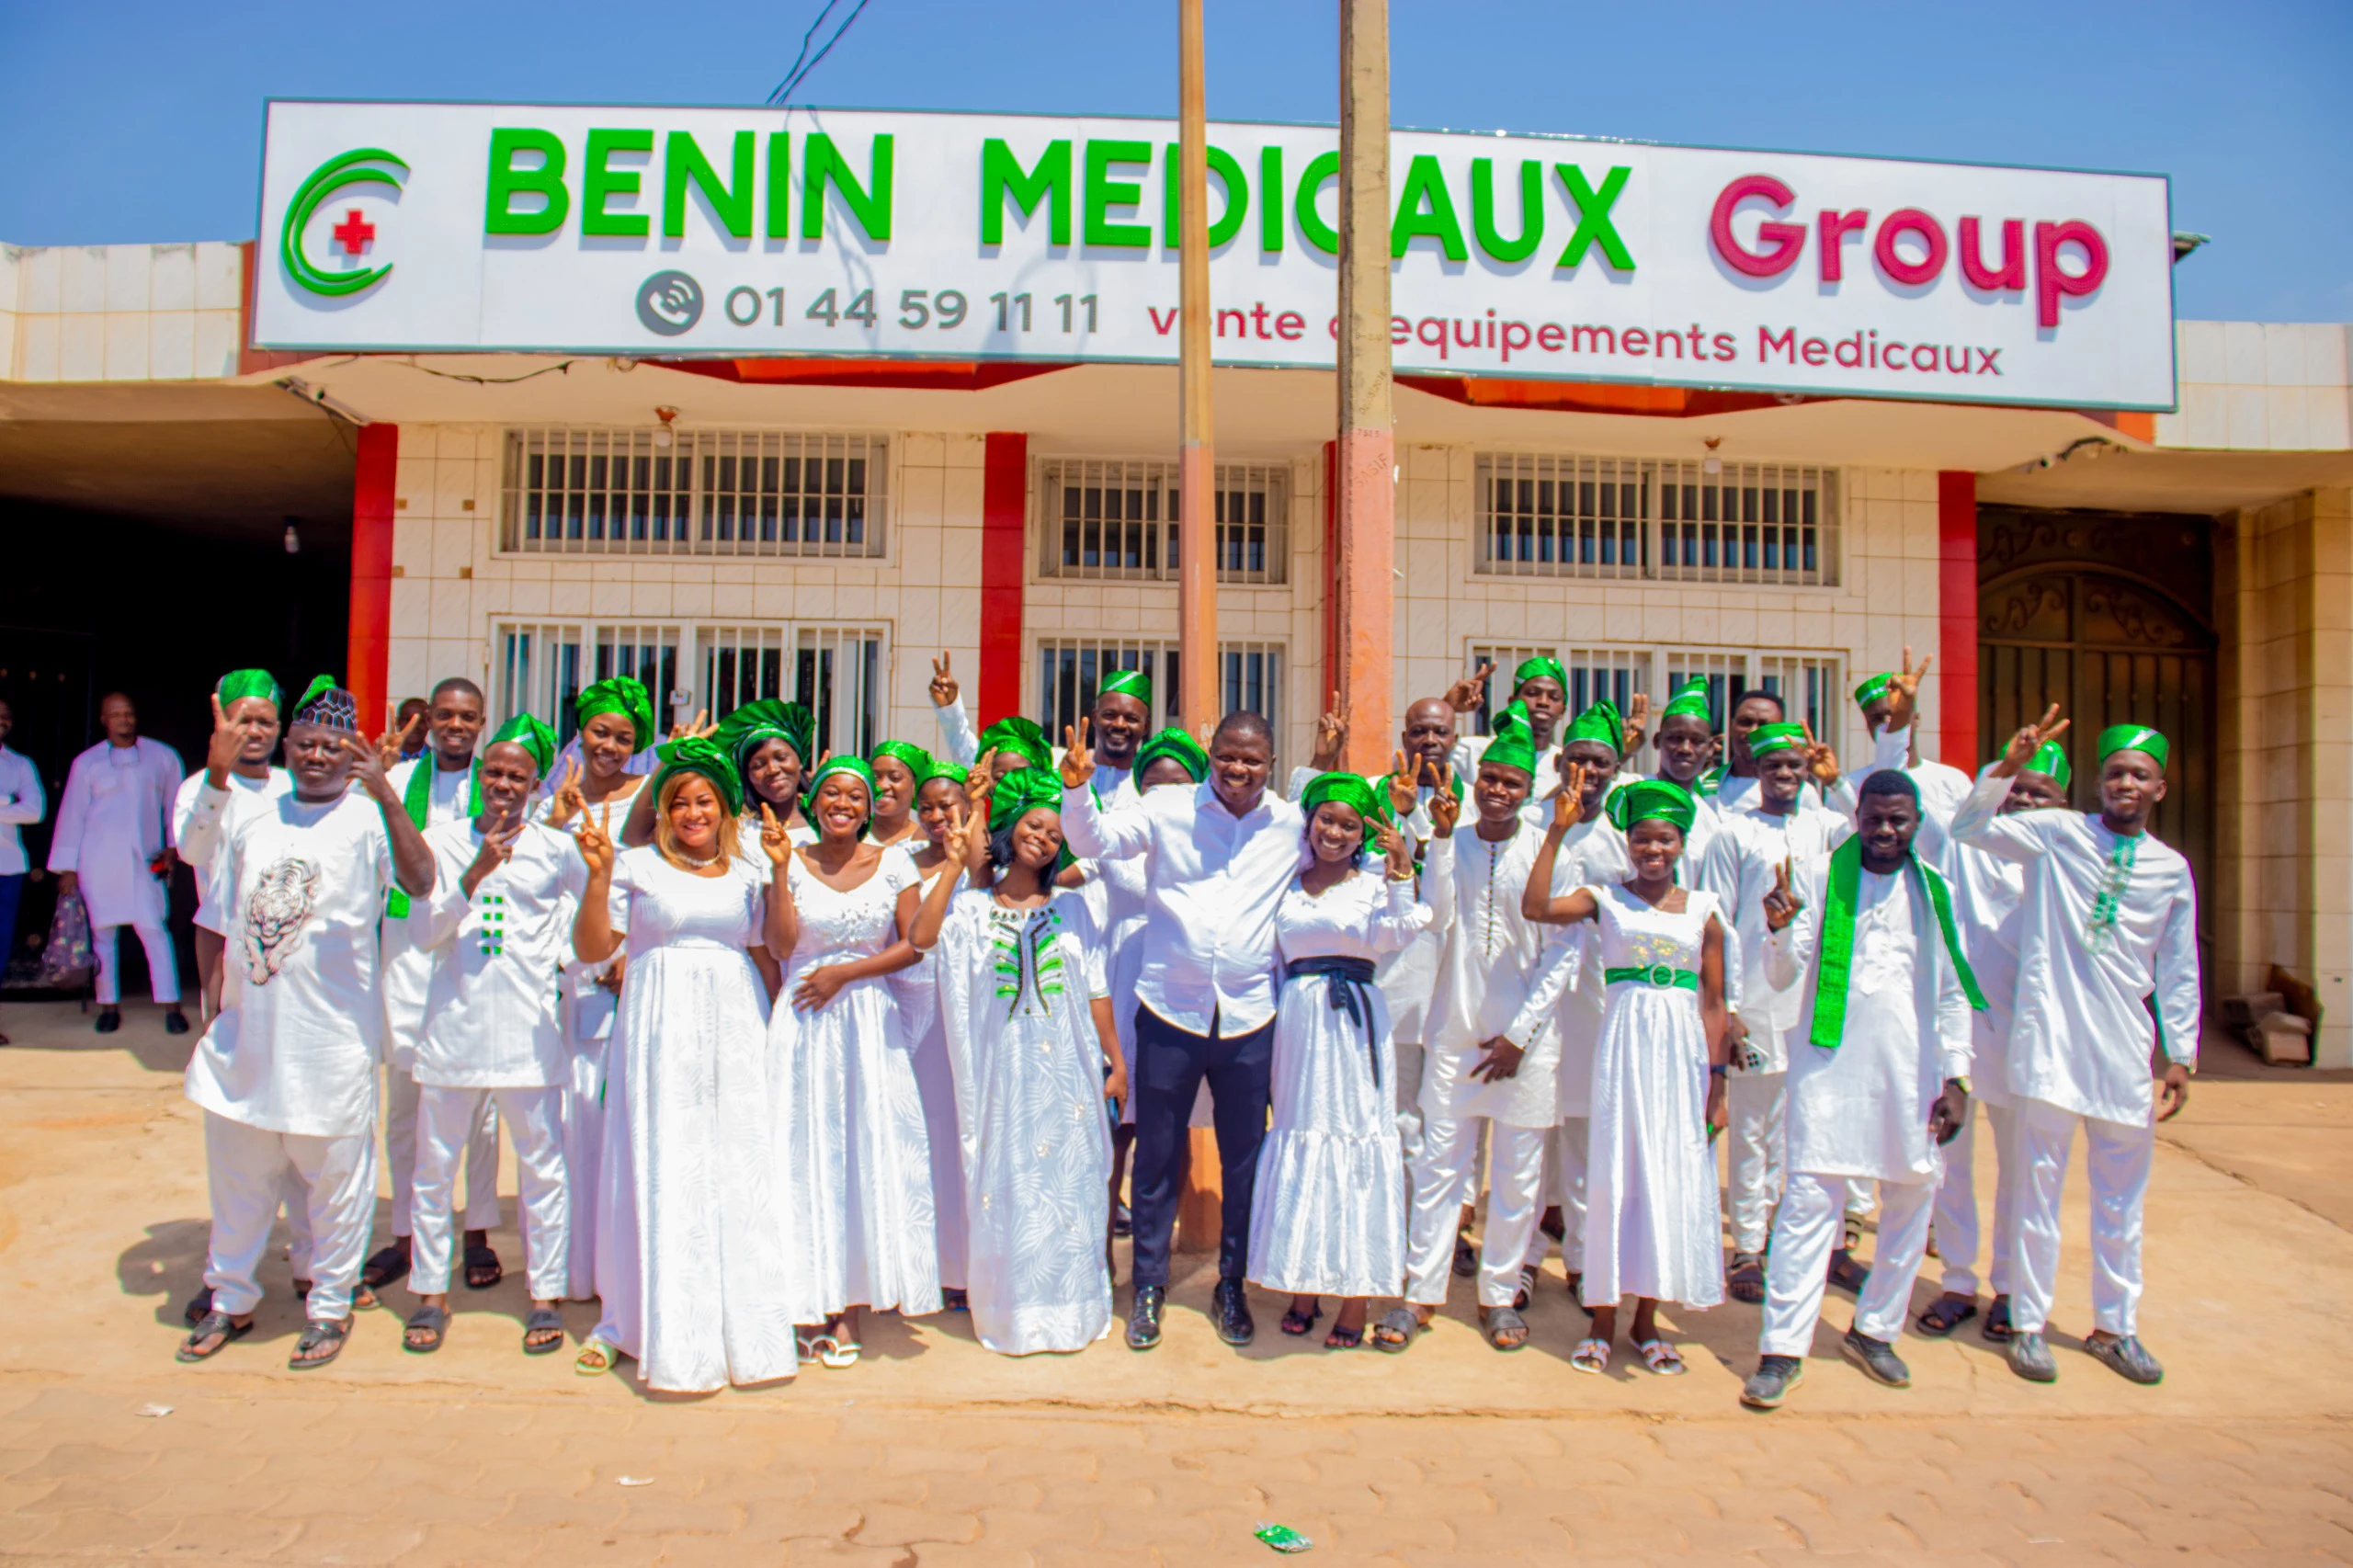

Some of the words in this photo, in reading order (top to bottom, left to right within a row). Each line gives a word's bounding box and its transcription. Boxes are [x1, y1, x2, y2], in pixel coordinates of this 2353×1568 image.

[484, 128, 895, 241] BENIN
[1709, 175, 2110, 328] Group
[724, 285, 785, 327] 01
[805, 287, 877, 329] 44
[898, 289, 968, 331] 59
[989, 291, 1032, 334] 11
[1054, 292, 1097, 335] 11
[1147, 301, 1306, 341] vnte
[1757, 327, 2003, 378] Medicaux
